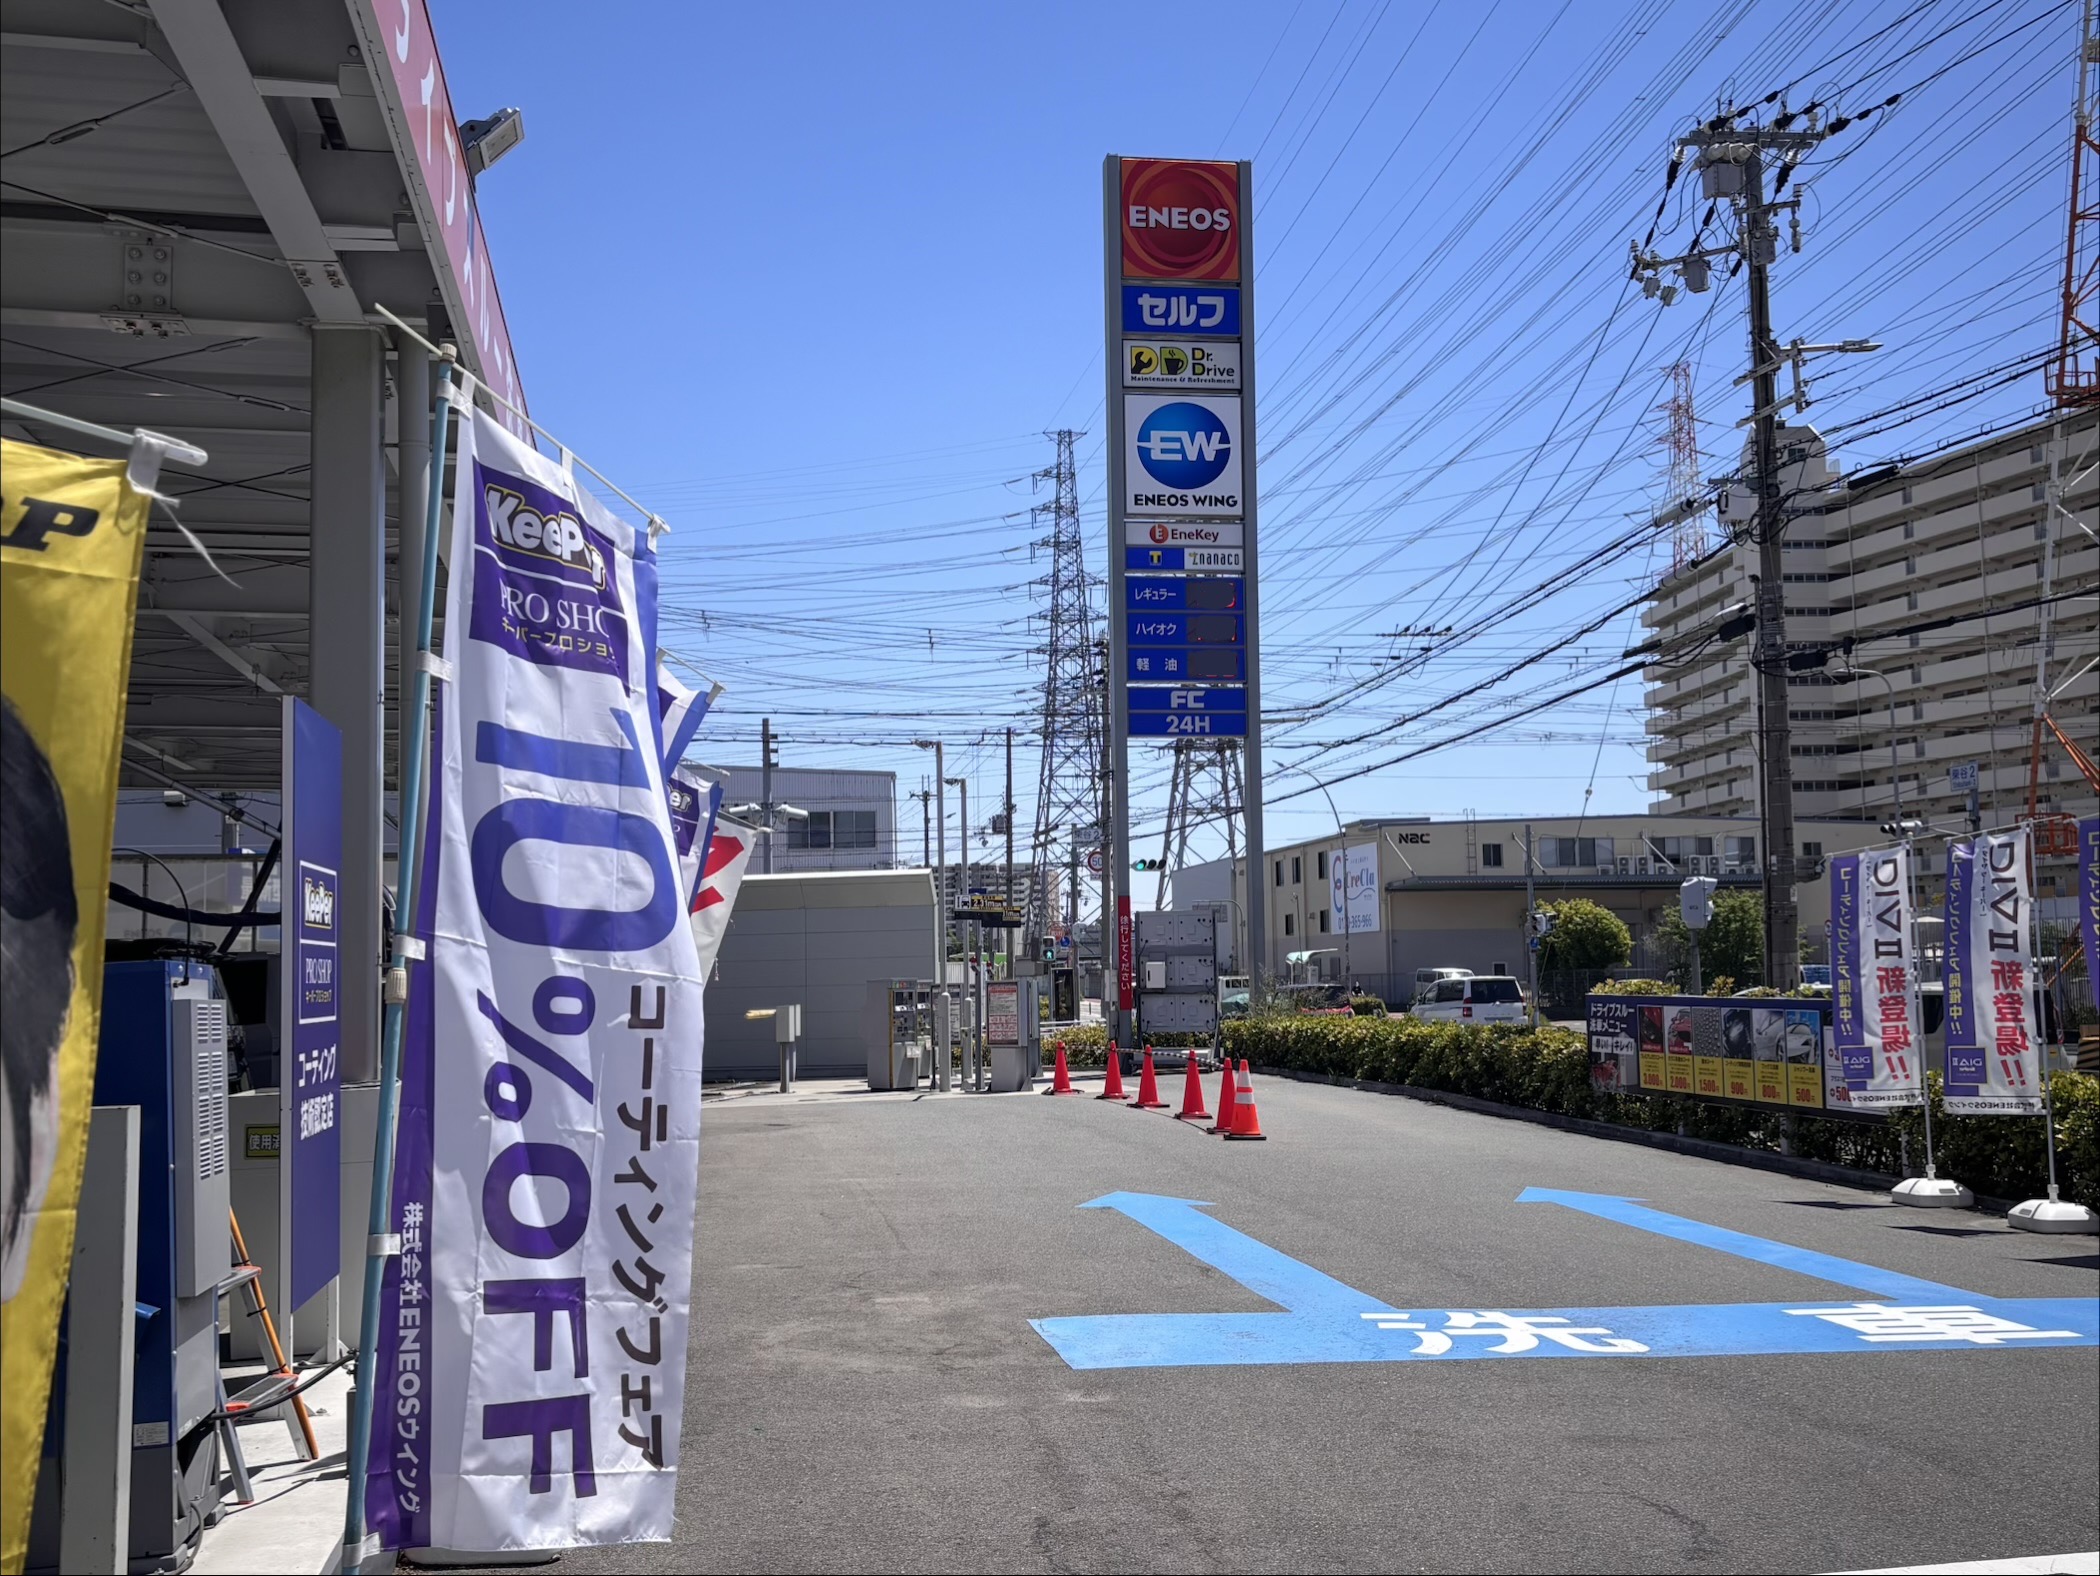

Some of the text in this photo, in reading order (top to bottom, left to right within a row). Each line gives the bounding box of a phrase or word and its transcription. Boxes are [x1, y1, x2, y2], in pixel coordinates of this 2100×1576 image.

[1129, 205, 1231, 232] ENEOS
[1137, 292, 1225, 327] セルフ
[1191, 347, 1213, 362] Dr.
[1192, 362, 1235, 377] Drive
[1130, 375, 1178, 383] Maintenance
[1187, 377, 1235, 385] Refreshment
[1149, 430, 1223, 462] EW
[1133, 494, 1238, 508] ENEOS WING
[0, 496, 99, 552] P
[1171, 529, 1220, 543] EneKey
[1199, 551, 1240, 566] nanaco
[500, 578, 550, 626] PRO
[1134, 588, 1177, 600] レギュラー
[1136, 622, 1177, 636] ハイオク
[1170, 690, 1206, 709] FC
[1165, 715, 1211, 734] 24H
[305, 877, 333, 926] KeePer
[1337, 913, 1373, 931] 01-365-966
[1119, 915, 1131, 991] 徐行してください
[305, 958, 333, 984] PRO SHOP
[1590, 1003, 1635, 1018] ドライブスルー
[1589, 1018, 1628, 1033] 洗車メニュー
[298, 1043, 337, 1088] コーティング
[612, 984, 669, 1472] コーティングフェア
[396, 1201, 424, 1514] 株式会社ENEOSウイング
